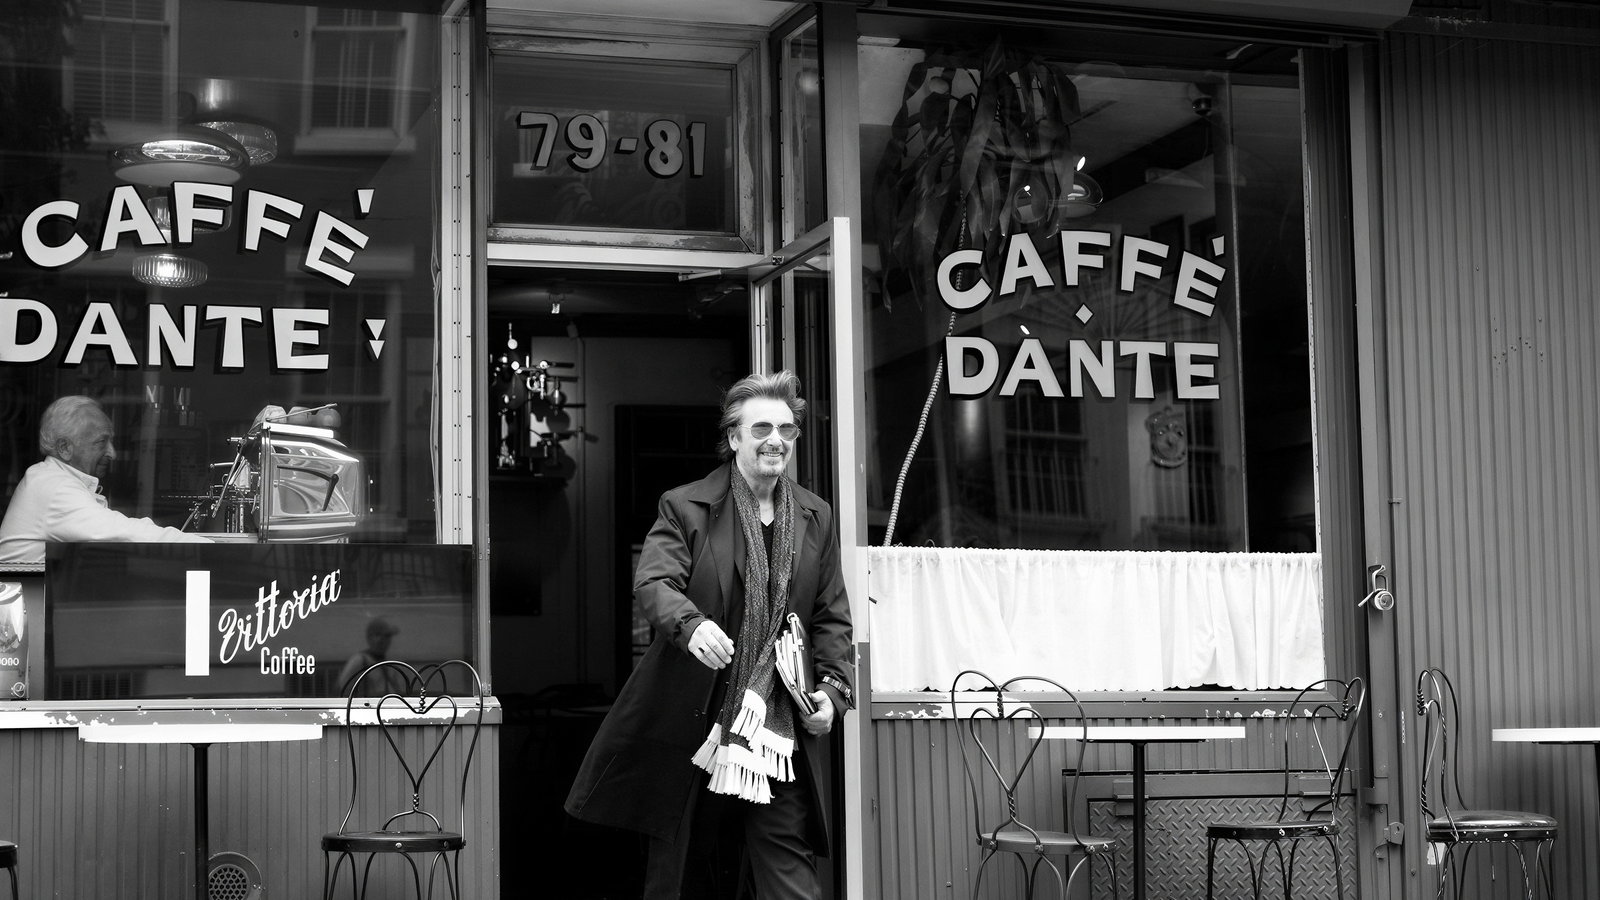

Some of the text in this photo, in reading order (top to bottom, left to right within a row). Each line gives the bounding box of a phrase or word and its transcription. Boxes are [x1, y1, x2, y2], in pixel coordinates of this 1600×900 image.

[516, 111, 706, 178] 79-81
[0, 298, 329, 370] DANTE
[945, 336, 1220, 399] DANTE
[218, 568, 342, 664] Vittoria
[260, 646, 316, 675] Coffee
